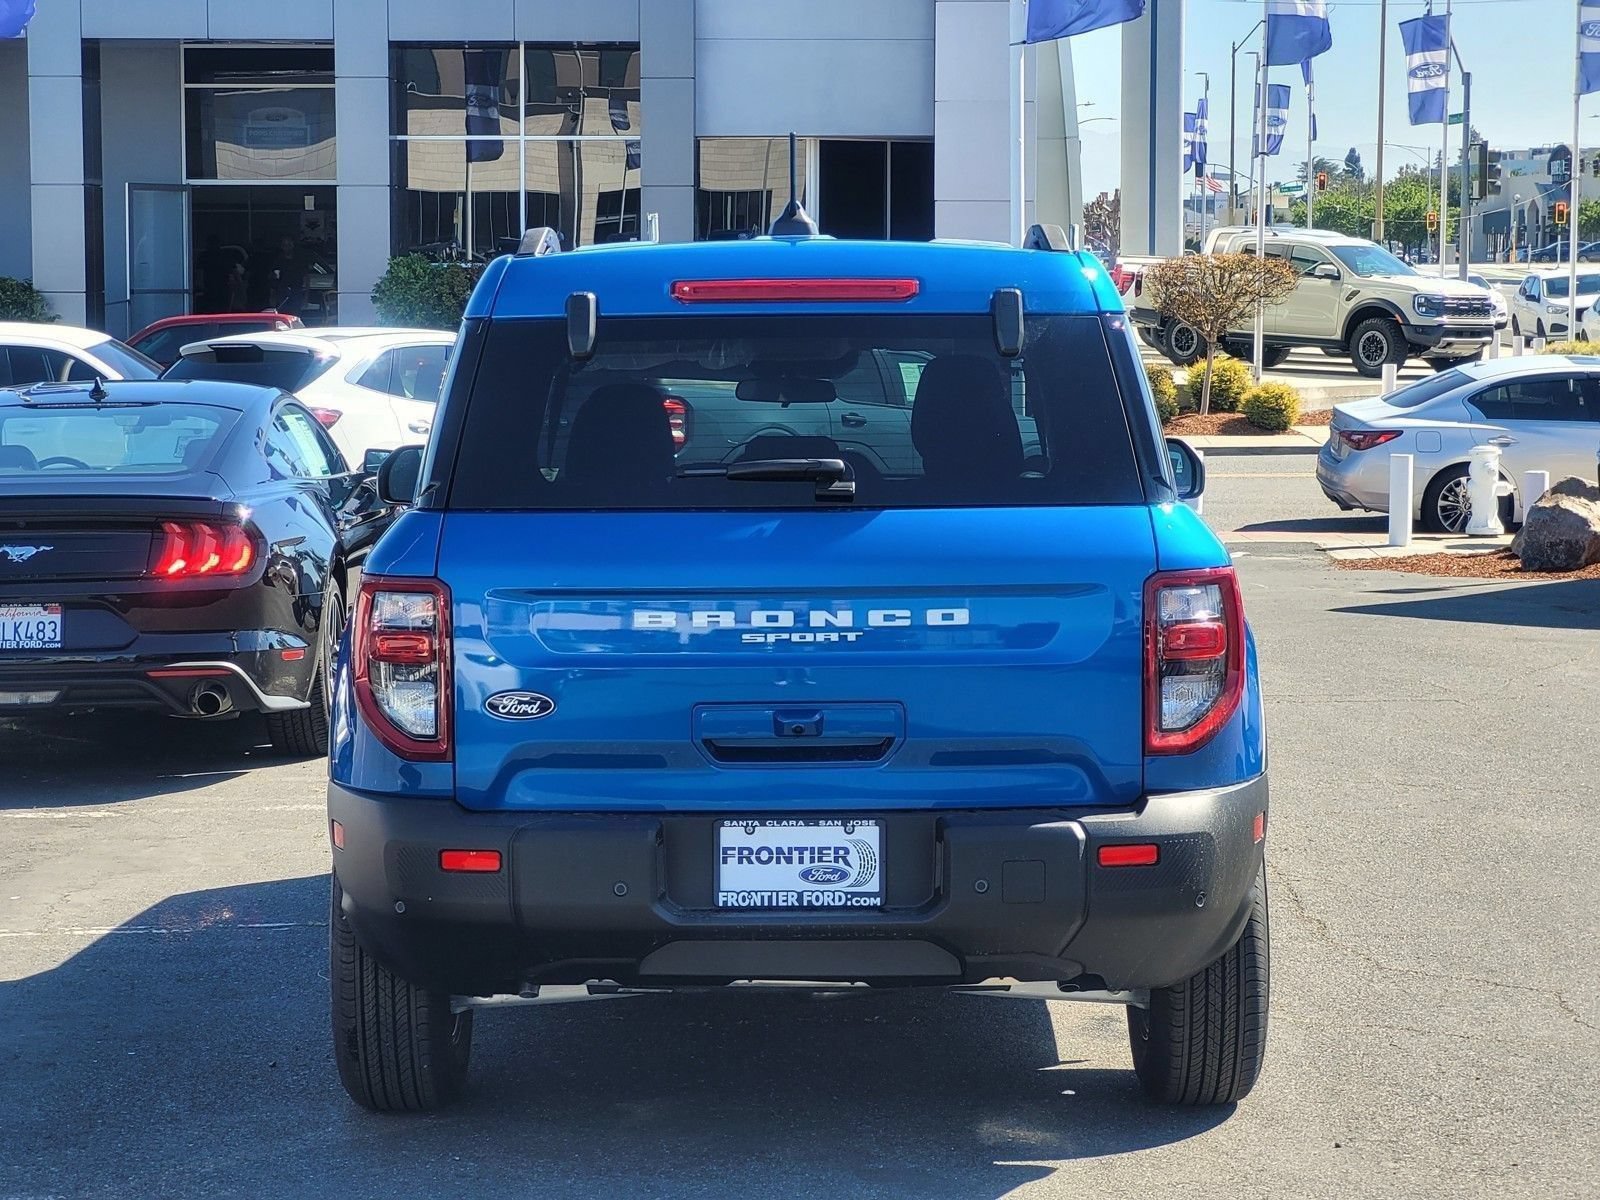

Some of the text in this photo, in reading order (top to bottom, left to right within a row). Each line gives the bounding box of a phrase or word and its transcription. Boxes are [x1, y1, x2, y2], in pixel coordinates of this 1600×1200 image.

[633, 608, 970, 628] BRONCO
[741, 631, 864, 643] SPORT
[498, 695, 541, 714] Ford
[721, 846, 854, 870] FRONTIER
[808, 868, 841, 881] Ford
[718, 891, 799, 907] FRONTIER
